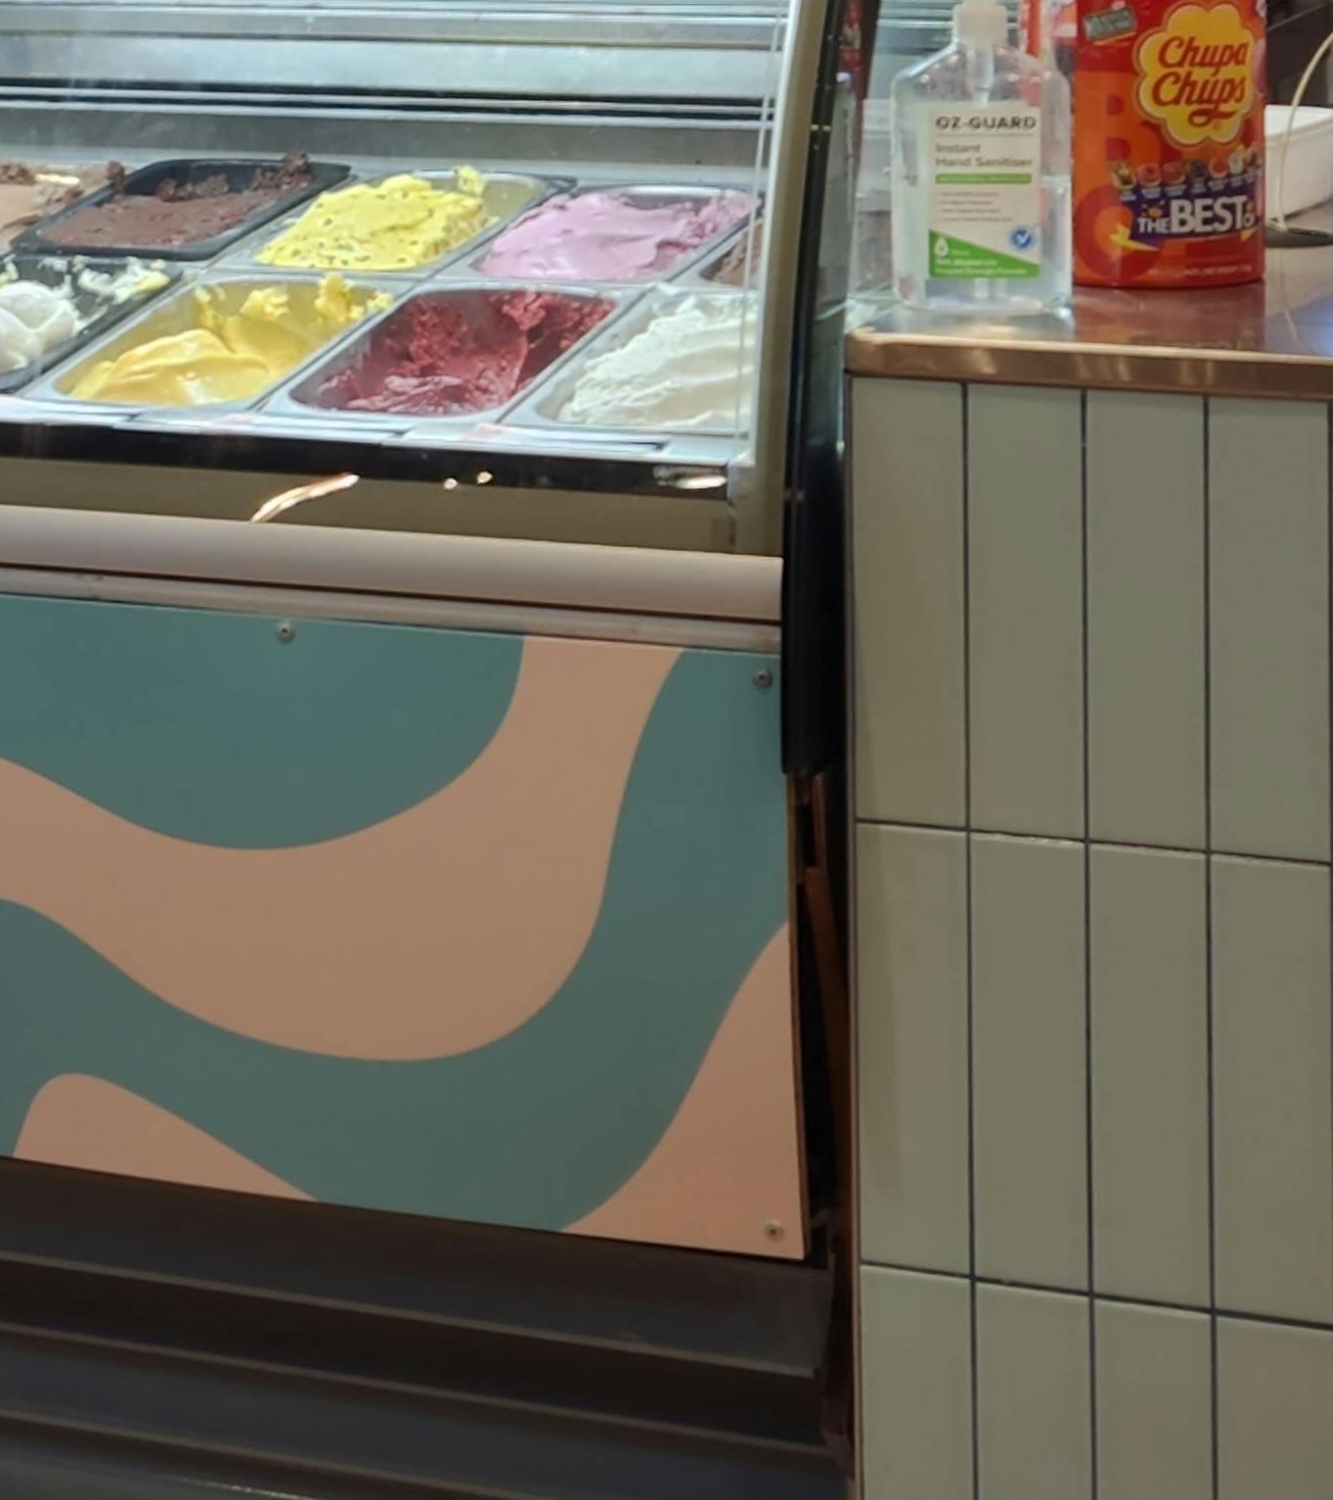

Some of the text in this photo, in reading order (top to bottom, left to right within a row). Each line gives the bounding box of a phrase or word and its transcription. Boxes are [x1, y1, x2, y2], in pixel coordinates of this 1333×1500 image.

[1158, 36, 1248, 81] Chupa
[1151, 71, 1248, 126] Chups
[935, 115, 1037, 131] OZ-GUARD
[936, 141, 982, 155] Instant
[936, 155, 1035, 169] Hand Sanitiser
[1138, 195, 1247, 234] THE BEST
